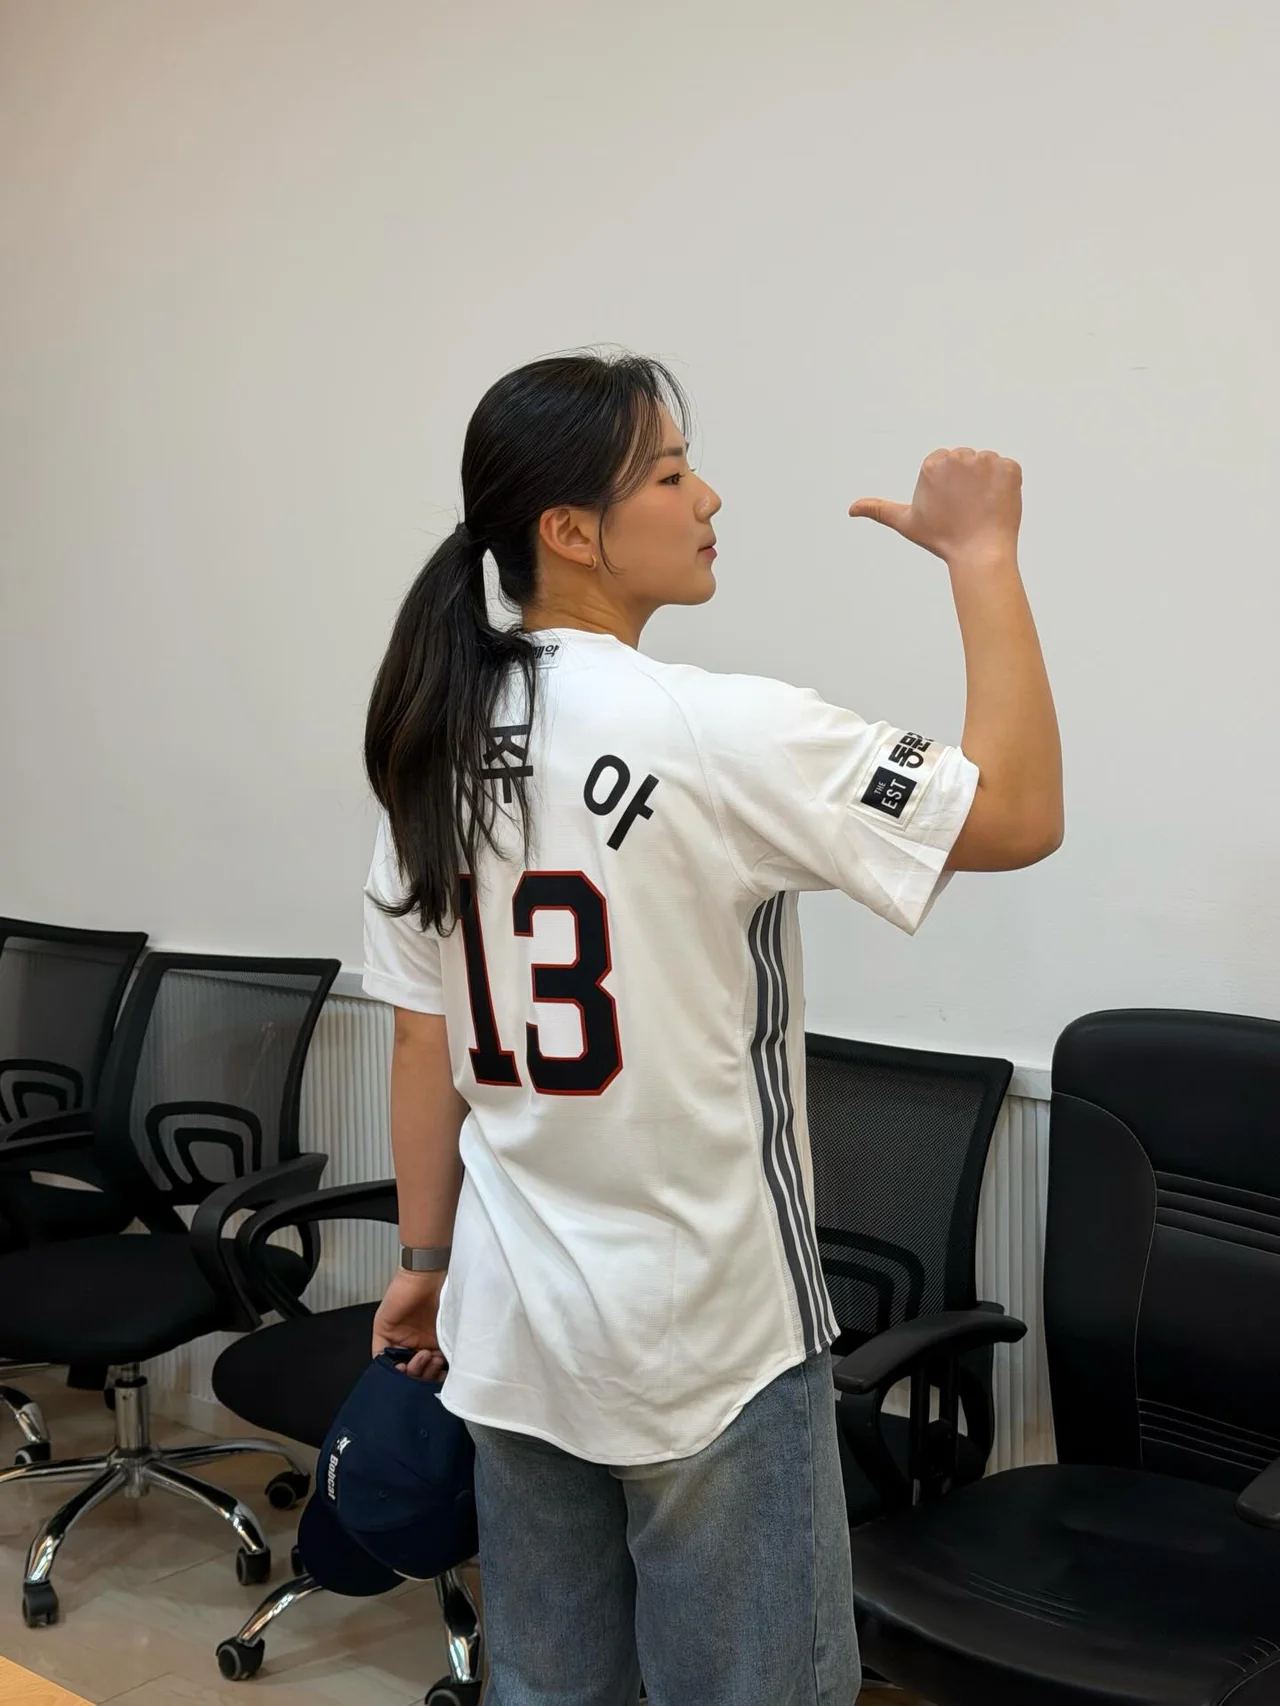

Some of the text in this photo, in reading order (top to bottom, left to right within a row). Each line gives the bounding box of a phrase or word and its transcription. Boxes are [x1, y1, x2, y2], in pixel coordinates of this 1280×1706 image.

[888, 732, 935, 769] 동문
[482, 724, 660, 851] 주아
[873, 781, 886, 795] THE
[881, 778, 907, 810] EST
[458, 870, 624, 1096] 13
[327, 1454, 339, 1500] Bobcat
